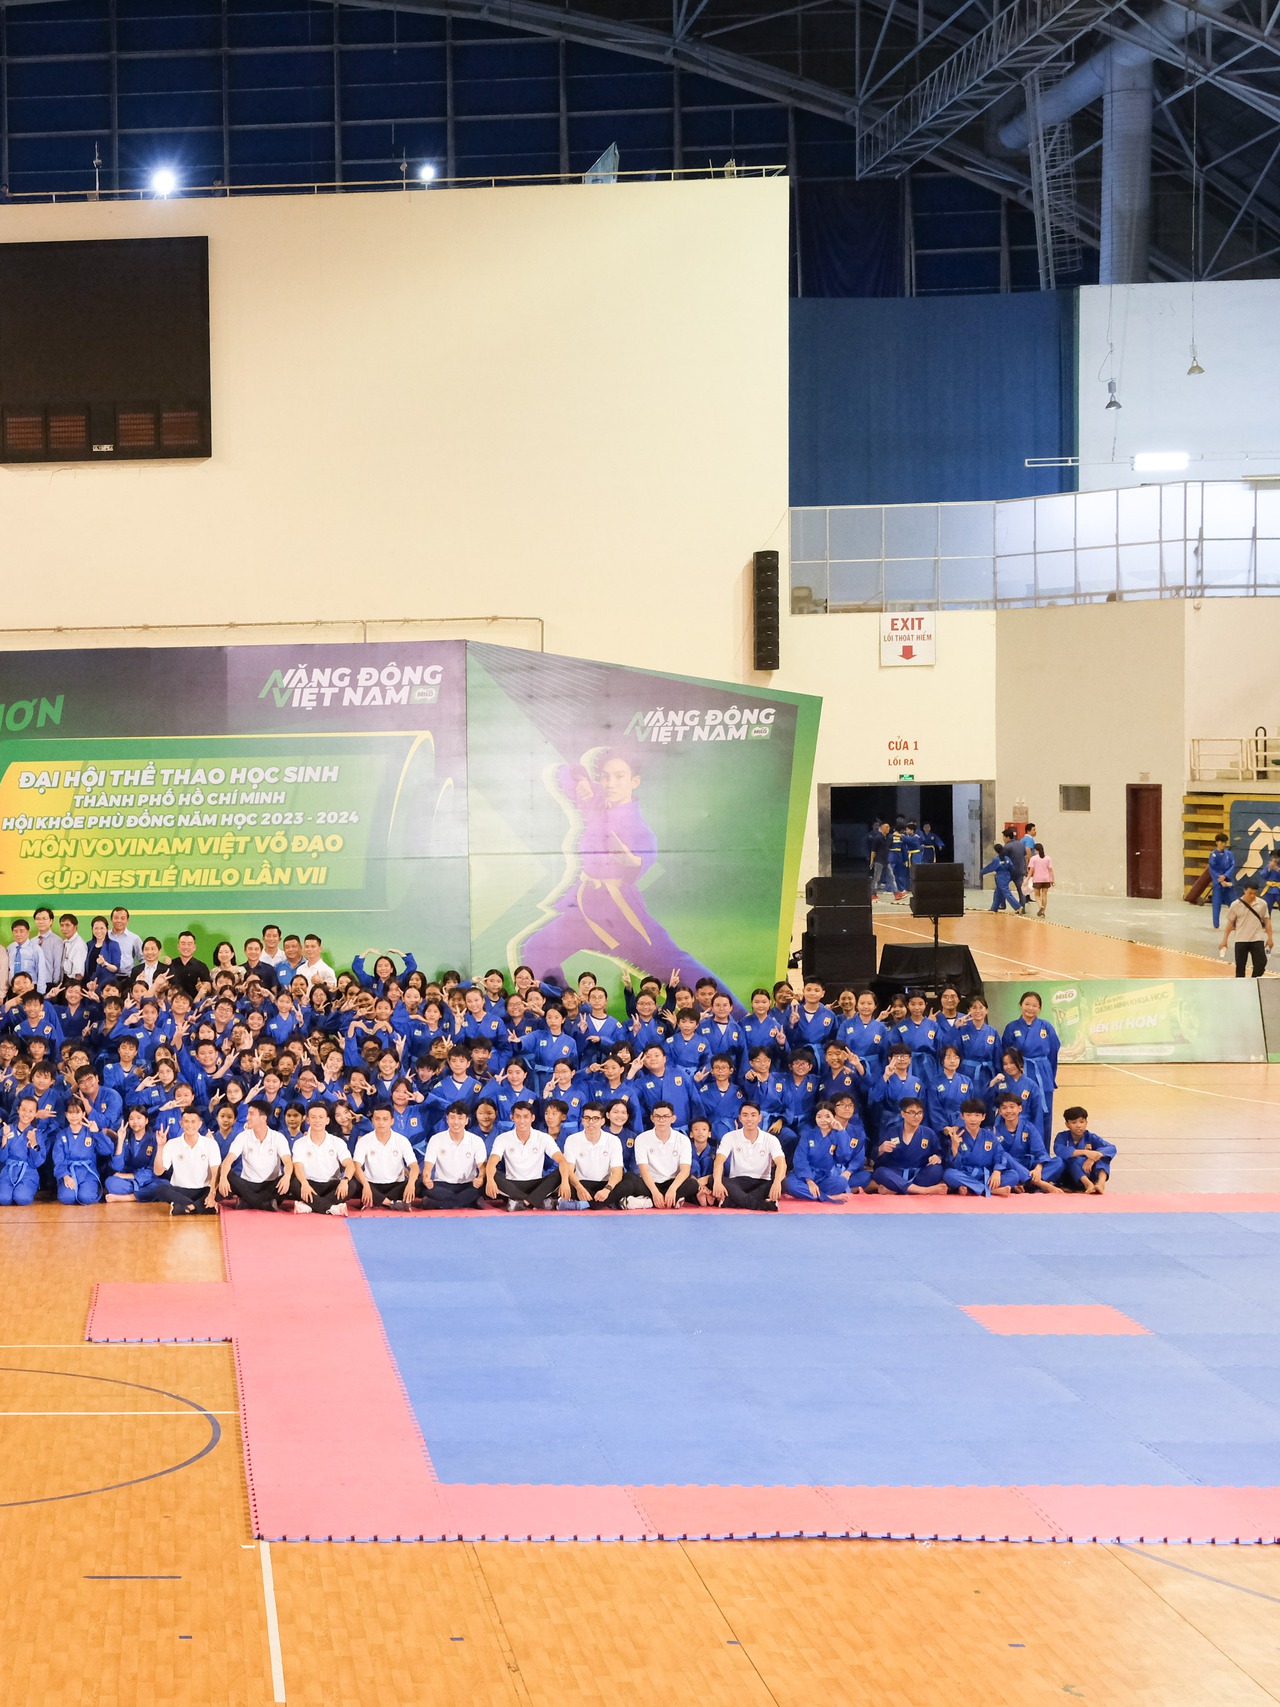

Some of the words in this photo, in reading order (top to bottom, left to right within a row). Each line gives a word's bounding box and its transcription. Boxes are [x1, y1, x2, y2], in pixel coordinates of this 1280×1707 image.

[891, 618, 924, 630] EXIT
[272, 681, 339, 710] VIỆT
[343, 686, 410, 706] NAM
[635, 721, 690, 744] VIỆT
[692, 725, 748, 742] NAM
[888, 736, 909, 750] CỬA
[913, 740, 918, 750] 1
[904, 758, 914, 766] RA
[18, 770, 60, 794] ĐẠI
[64, 766, 106, 793] HỘI
[110, 760, 156, 787] THỂ
[160, 768, 226, 786] THAO
[230, 767, 279, 790] HỌC
[283, 766, 340, 783] SINH
[74, 792, 134, 808] THÀNH
[138, 788, 175, 806] PHỐ
[178, 788, 204, 806] HỒ
[207, 790, 238, 806] CHÍ
[240, 792, 286, 804] MINH
[2, 813, 33, 834] HỘI
[36, 812, 86, 830] KHỎE
[86, 812, 124, 828] PHÙ
[126, 808, 174, 828] ĐỔNG
[178, 810, 218, 826] NĂM
[220, 813, 258, 830] HỌC
[260, 812, 304, 825] 2023
[316, 811, 360, 824] 2024
[20, 834, 78, 858] MÔN
[81, 837, 192, 857] VOVINAM
[197, 832, 251, 860] VIỆT
[254, 830, 288, 854] VÕ
[291, 834, 344, 859] ĐẠO
[38, 866, 86, 890] CÚP
[88, 864, 178, 888] NESTLÉ
[180, 868, 240, 886] MILO
[243, 860, 292, 886] LẦN
[296, 866, 328, 884] VII
[1055, 992, 1074, 1000] MILO
